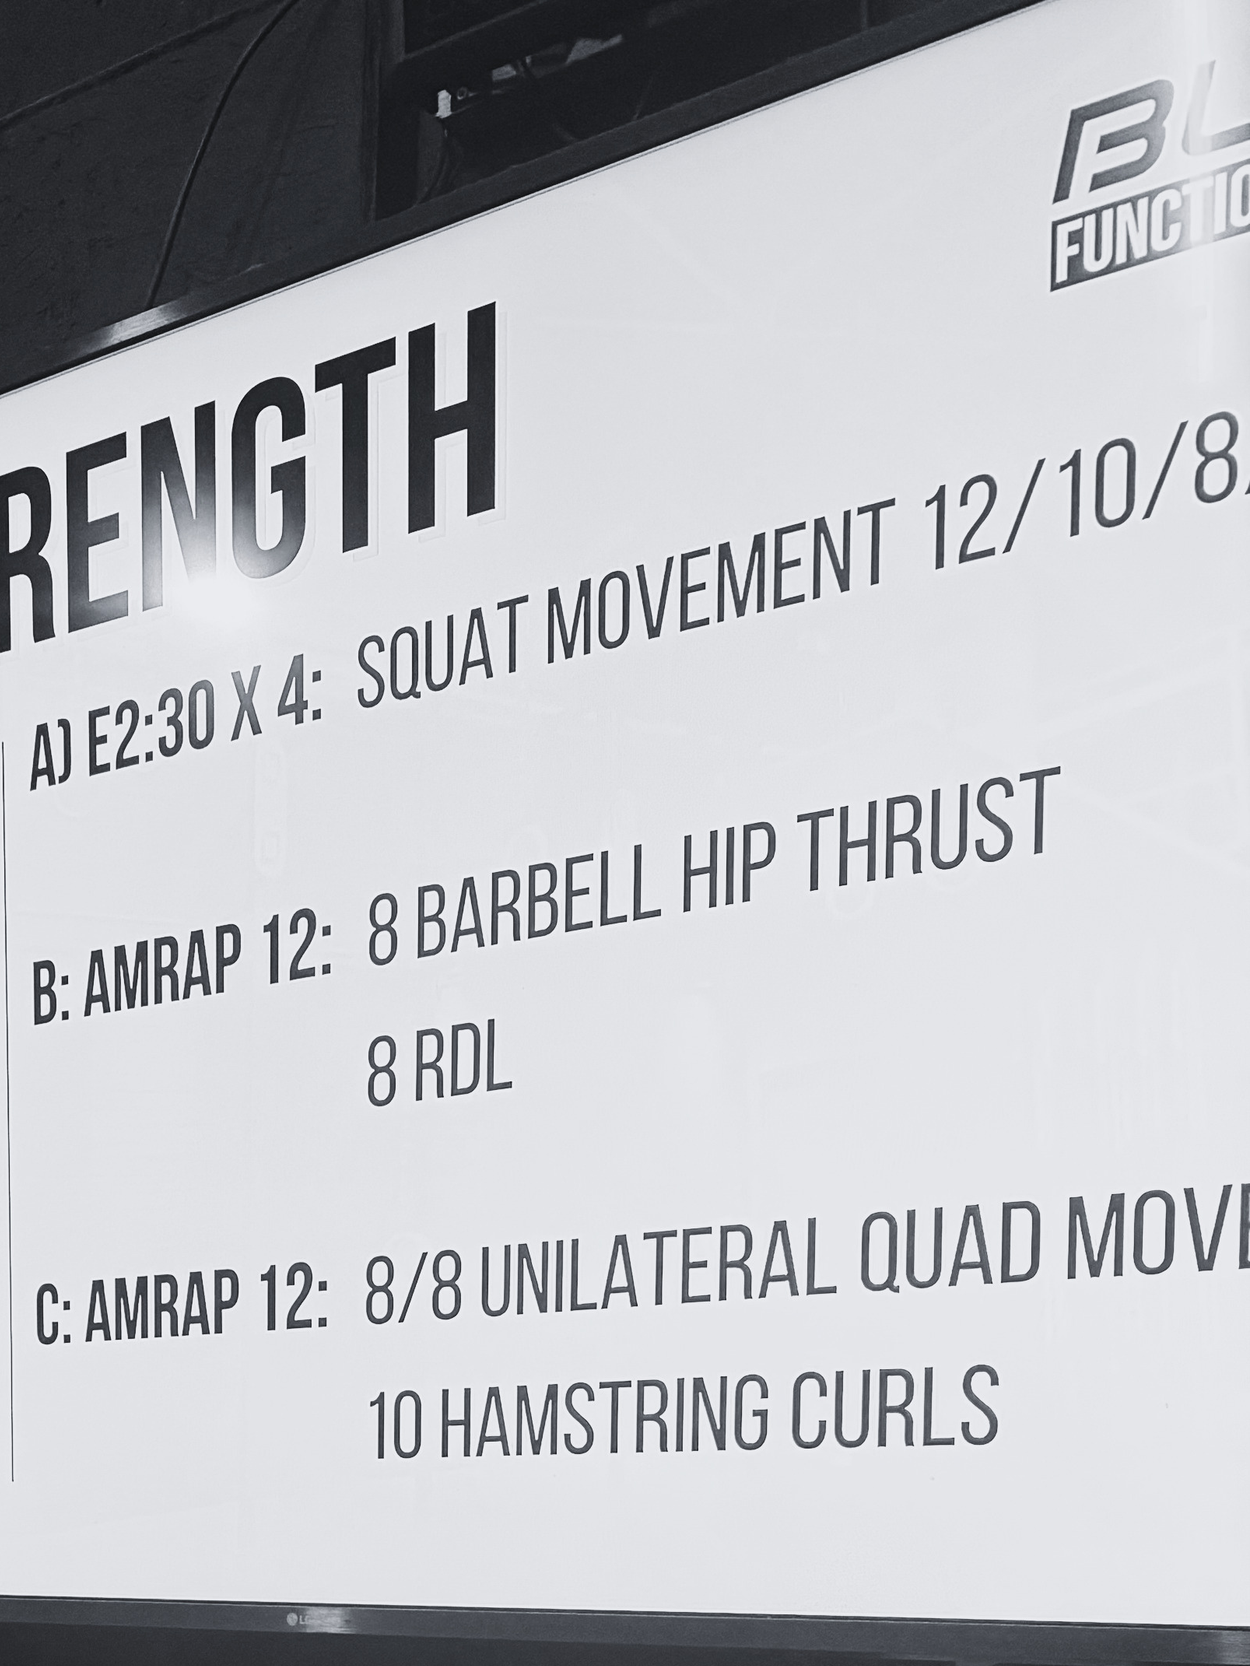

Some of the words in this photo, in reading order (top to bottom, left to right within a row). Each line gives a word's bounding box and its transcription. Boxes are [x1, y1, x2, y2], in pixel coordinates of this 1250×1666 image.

[30, 719, 71, 791] A)
[89, 680, 214, 776] E2:30
[231, 665, 262, 741] X
[278, 654, 321, 725] 4:
[358, 595, 528, 708] SQUAT
[548, 498, 895, 664] MOVEMENT
[925, 412, 1250, 570] 12/10/8
[33, 960, 69, 1025] B:
[84, 924, 241, 1017] AMRAP
[263, 908, 331, 984] 12:
[369, 893, 398, 965] 8
[417, 844, 661, 958] BARBELL
[683, 822, 776, 912] HIP
[797, 766, 1061, 891] THRUST
[368, 1035, 396, 1106] 8
[416, 1019, 512, 1101] RDL
[37, 1283, 70, 1345] C:
[85, 1269, 239, 1342] AMRAP
[261, 1262, 327, 1331] 12:
[366, 1250, 461, 1324] 8/8
[482, 1218, 837, 1317] UNILATERAL
[861, 1201, 1040, 1293] QUAD
[370, 1390, 421, 1459] 10
[442, 1374, 768, 1457] HAMSTRING
[792, 1365, 999, 1450] CURLS
